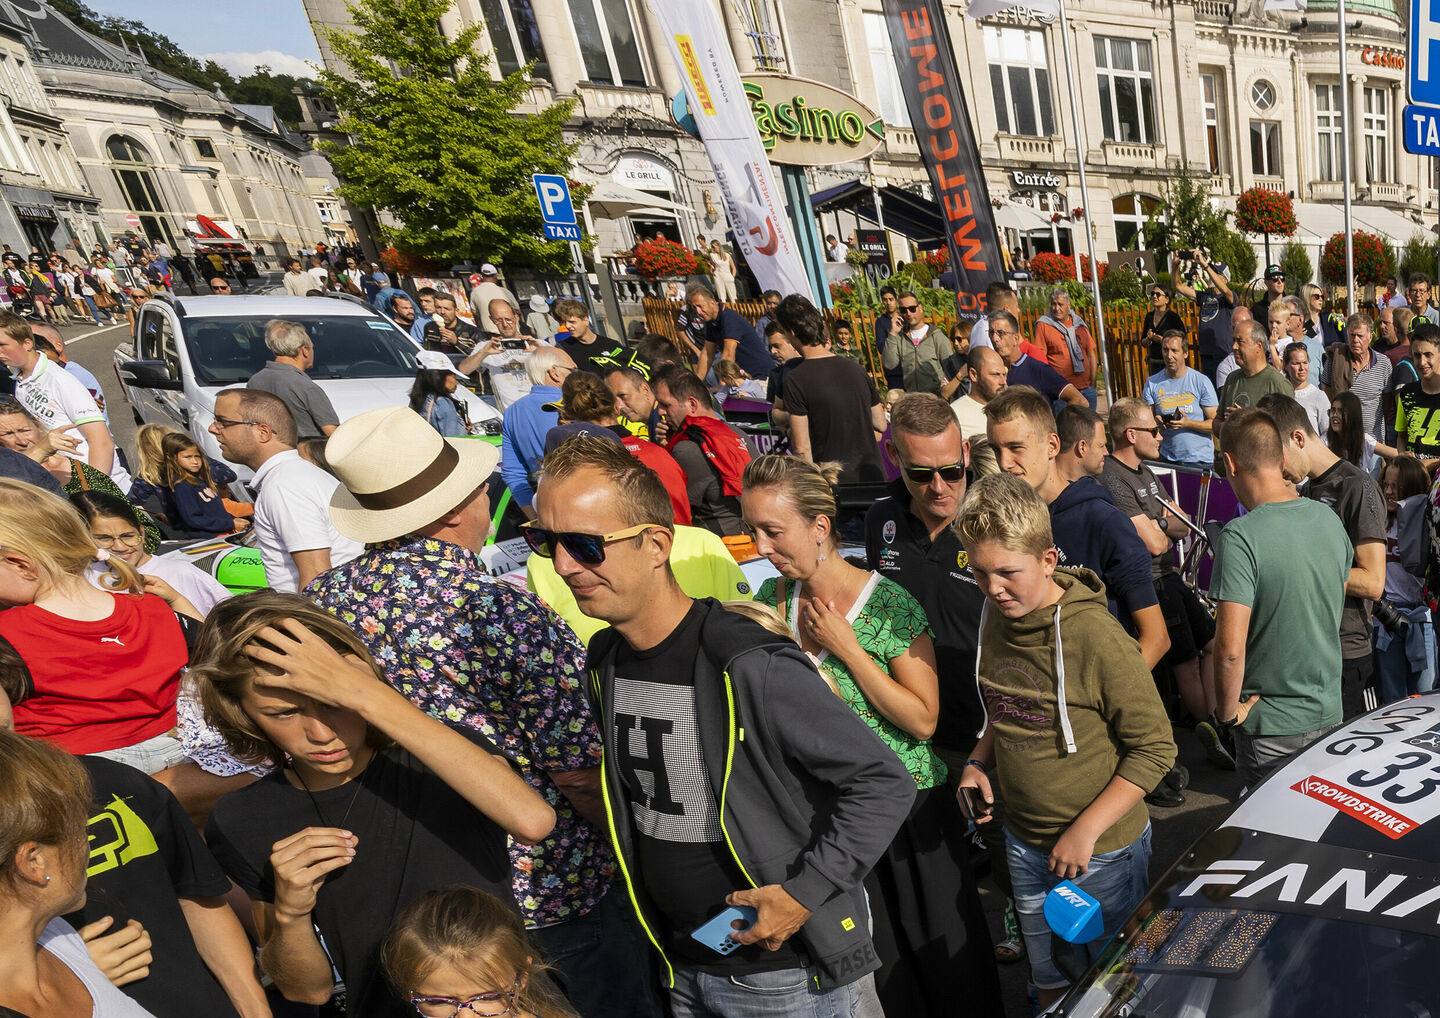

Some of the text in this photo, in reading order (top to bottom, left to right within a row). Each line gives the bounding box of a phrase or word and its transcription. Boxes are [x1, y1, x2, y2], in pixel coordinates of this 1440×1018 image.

[1362, 48, 1405, 70] Casino
[625, 171, 661, 180] LE GRILL
[1013, 170, 1061, 188] Entrée
[539, 182, 565, 216] P
[548, 225, 577, 239] TAXI
[1308, 780, 1411, 833] CROWDSTRIKE
[1054, 885, 1092, 908] WRT
